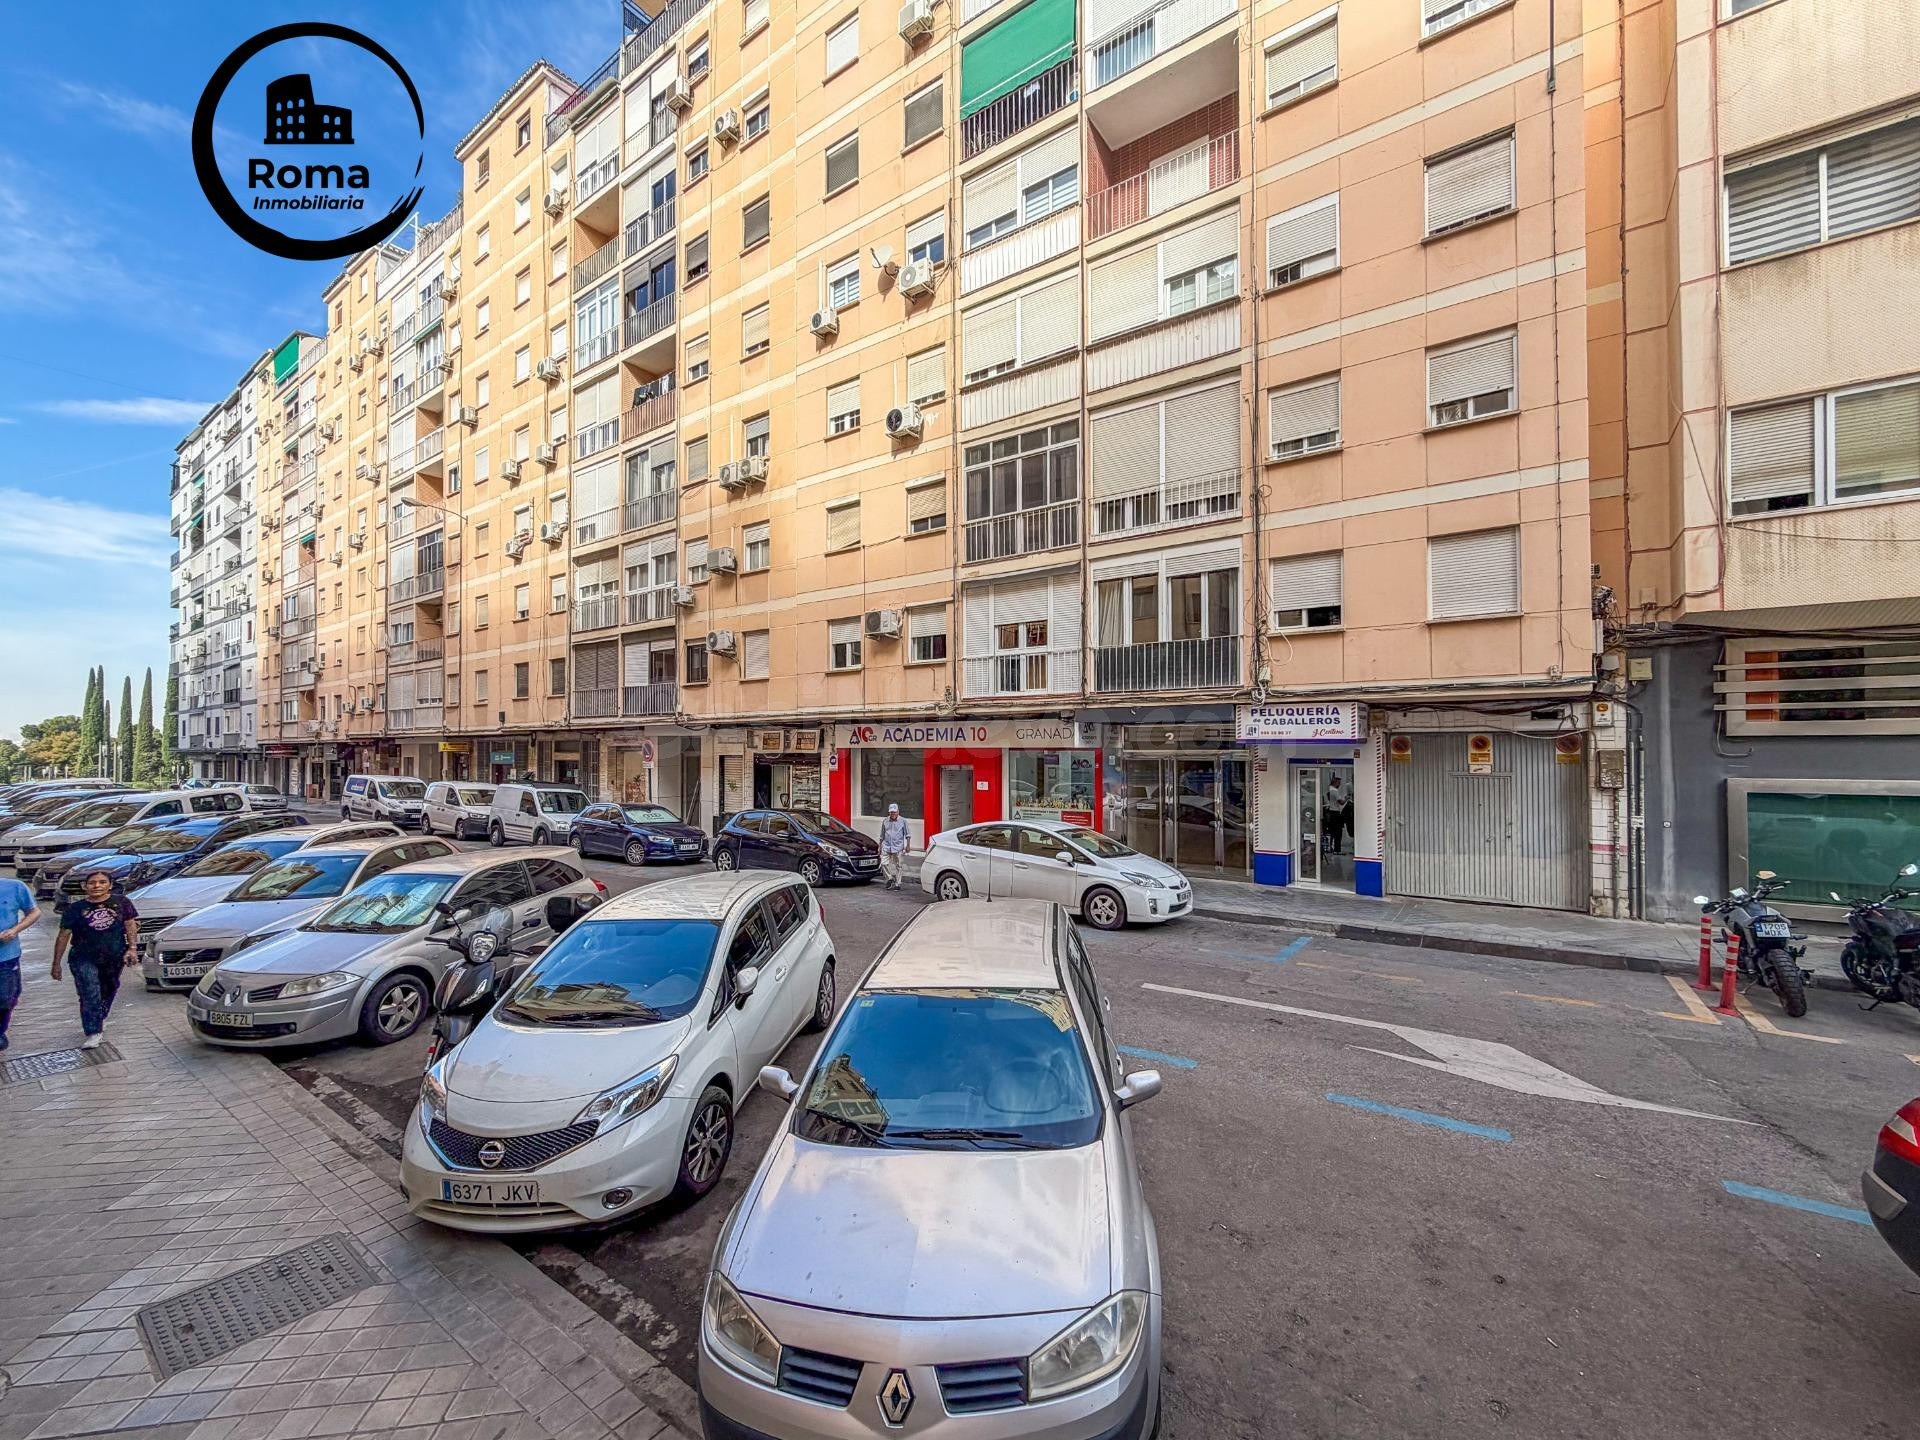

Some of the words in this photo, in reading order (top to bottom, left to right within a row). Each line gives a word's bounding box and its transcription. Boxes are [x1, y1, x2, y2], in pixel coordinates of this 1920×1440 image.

[1250, 705, 1341, 717] PELUQUERÍA
[1263, 717, 1341, 726] CABALLEROS
[882, 727, 967, 743] ACADEMIA
[970, 726, 987, 742] 10
[1015, 727, 1075, 740] GRANAD
[169, 967, 192, 977] 4030
[211, 1012, 232, 1025] 6805
[233, 1014, 251, 1026] FZL
[452, 1184, 493, 1200] 6371
[501, 1184, 535, 1201] JKV
